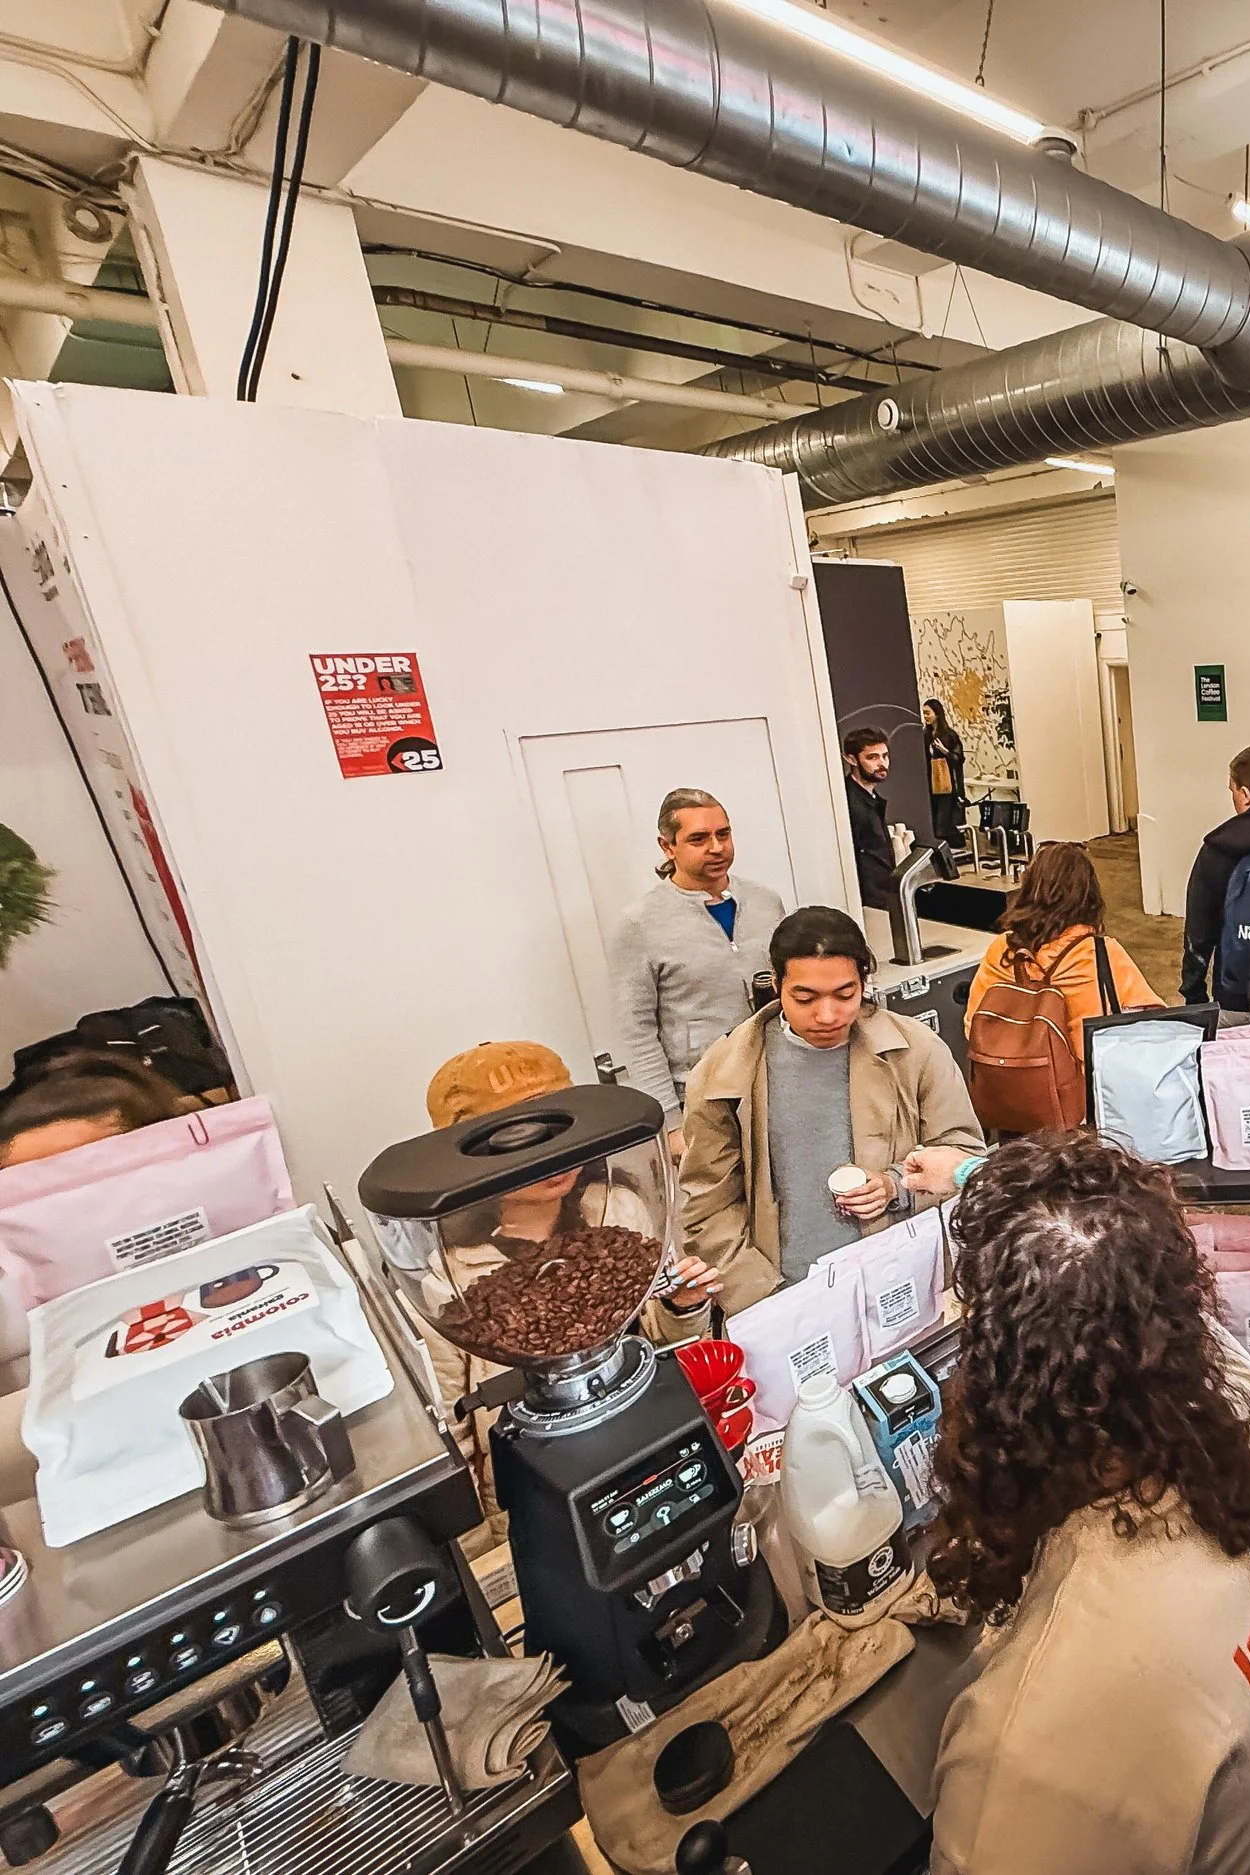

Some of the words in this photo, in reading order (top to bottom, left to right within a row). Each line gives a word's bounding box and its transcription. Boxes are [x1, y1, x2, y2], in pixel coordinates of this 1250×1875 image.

[312, 656, 412, 674] UNDER
[319, 674, 367, 691] 25?
[402, 750, 440, 770] 25
[211, 1292, 310, 1340] colombia
